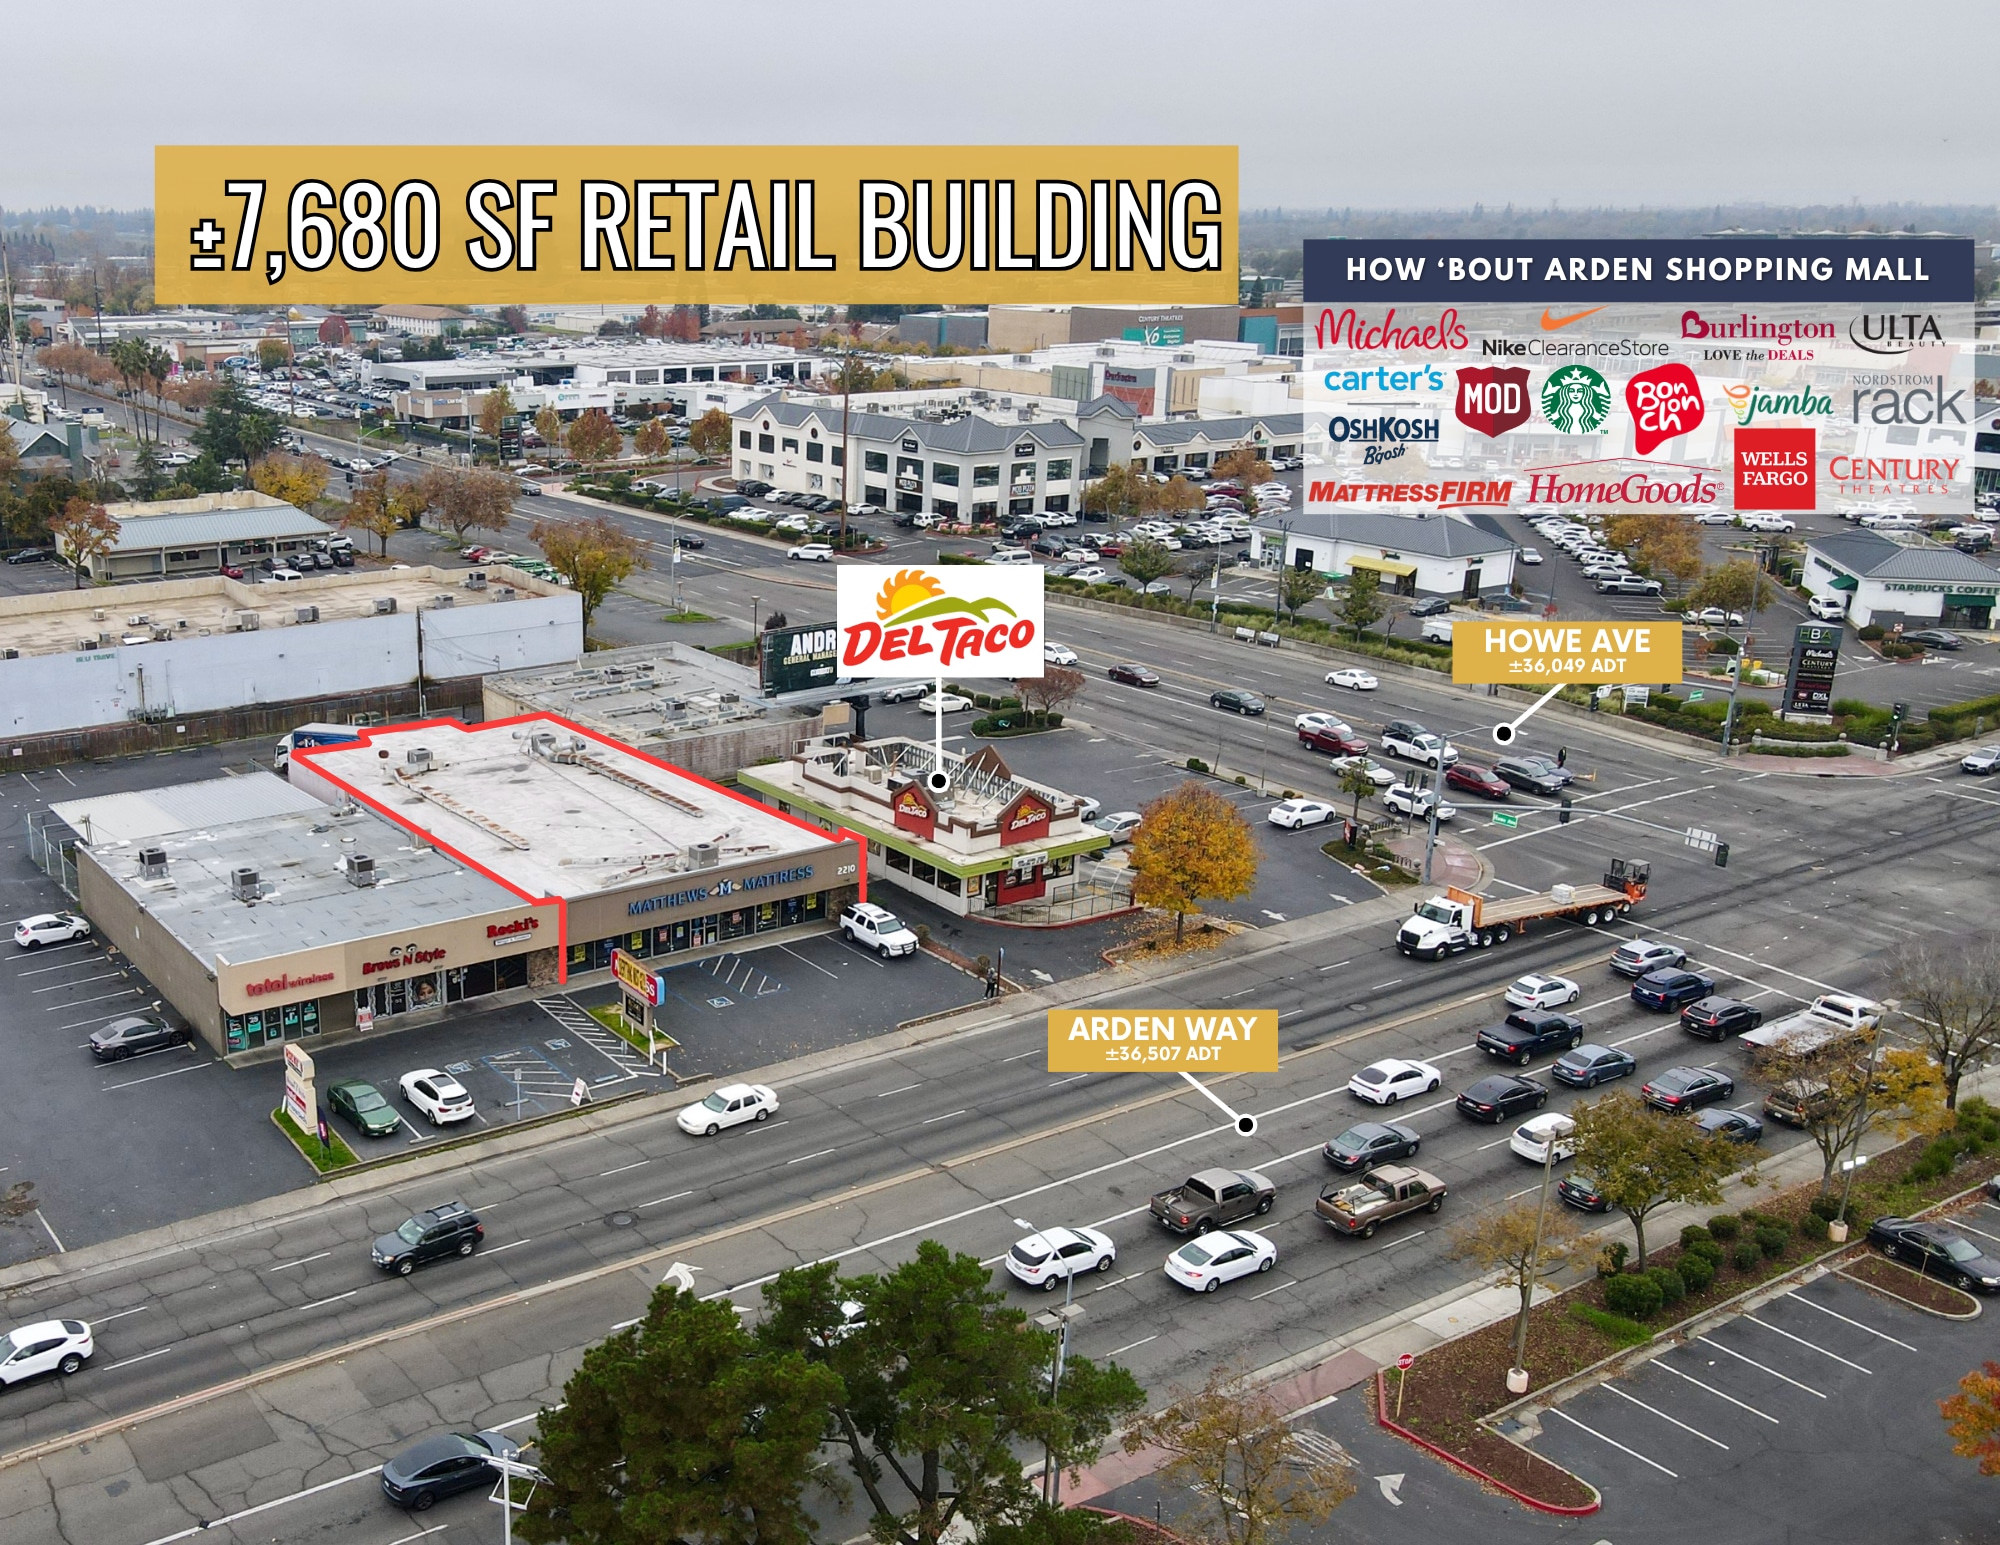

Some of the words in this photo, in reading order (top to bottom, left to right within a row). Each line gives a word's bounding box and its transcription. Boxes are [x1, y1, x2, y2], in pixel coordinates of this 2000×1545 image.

[1884, 583, 1954, 594] STARBUCKS
[1800, 628, 1832, 640] HBA
[783, 654, 811, 665] GENERAL
[1812, 691, 1829, 700] DXL
[837, 864, 856, 876] 2210
[628, 887, 708, 916] MATTHEWS
[743, 865, 815, 891] MATTRESS
[362, 958, 401, 975] Brows
[403, 951, 413, 966] N
[414, 947, 447, 964] Style
[246, 974, 288, 997] total
